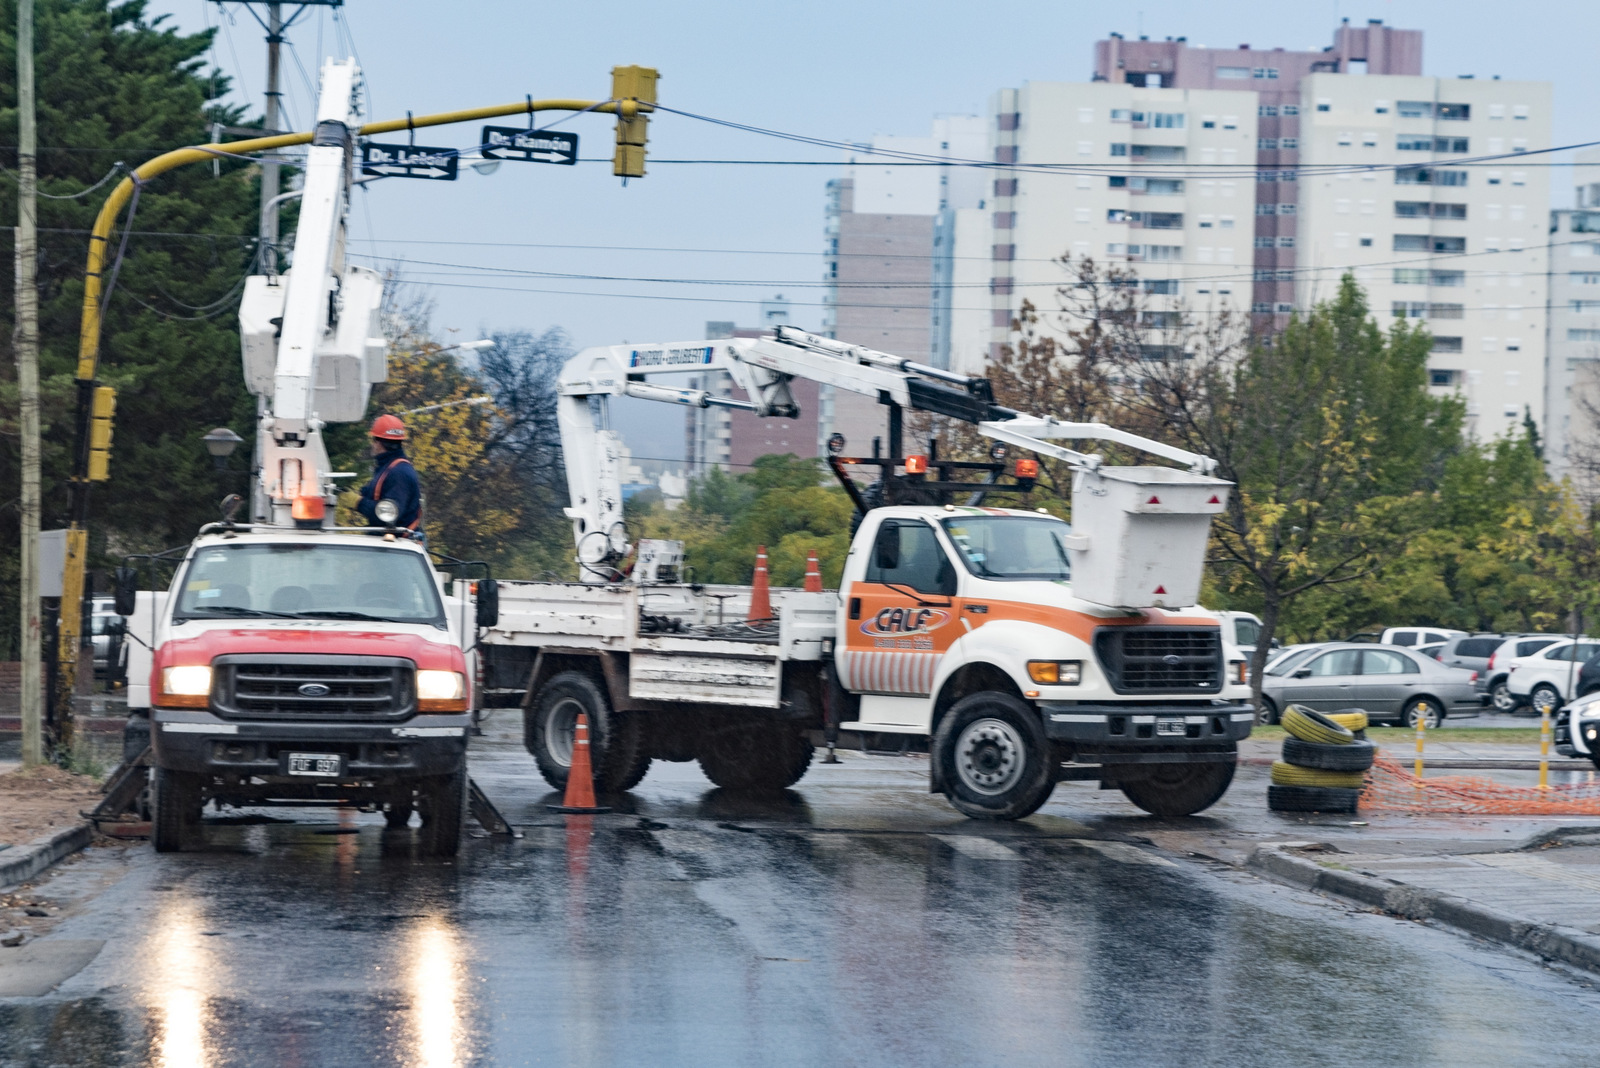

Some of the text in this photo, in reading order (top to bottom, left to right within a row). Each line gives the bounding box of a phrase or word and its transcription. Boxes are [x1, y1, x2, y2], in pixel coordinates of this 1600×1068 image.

[489, 131, 571, 152] Dr. Ramón
[368, 148, 393, 162] Dr.
[875, 607, 931, 633] CALF
